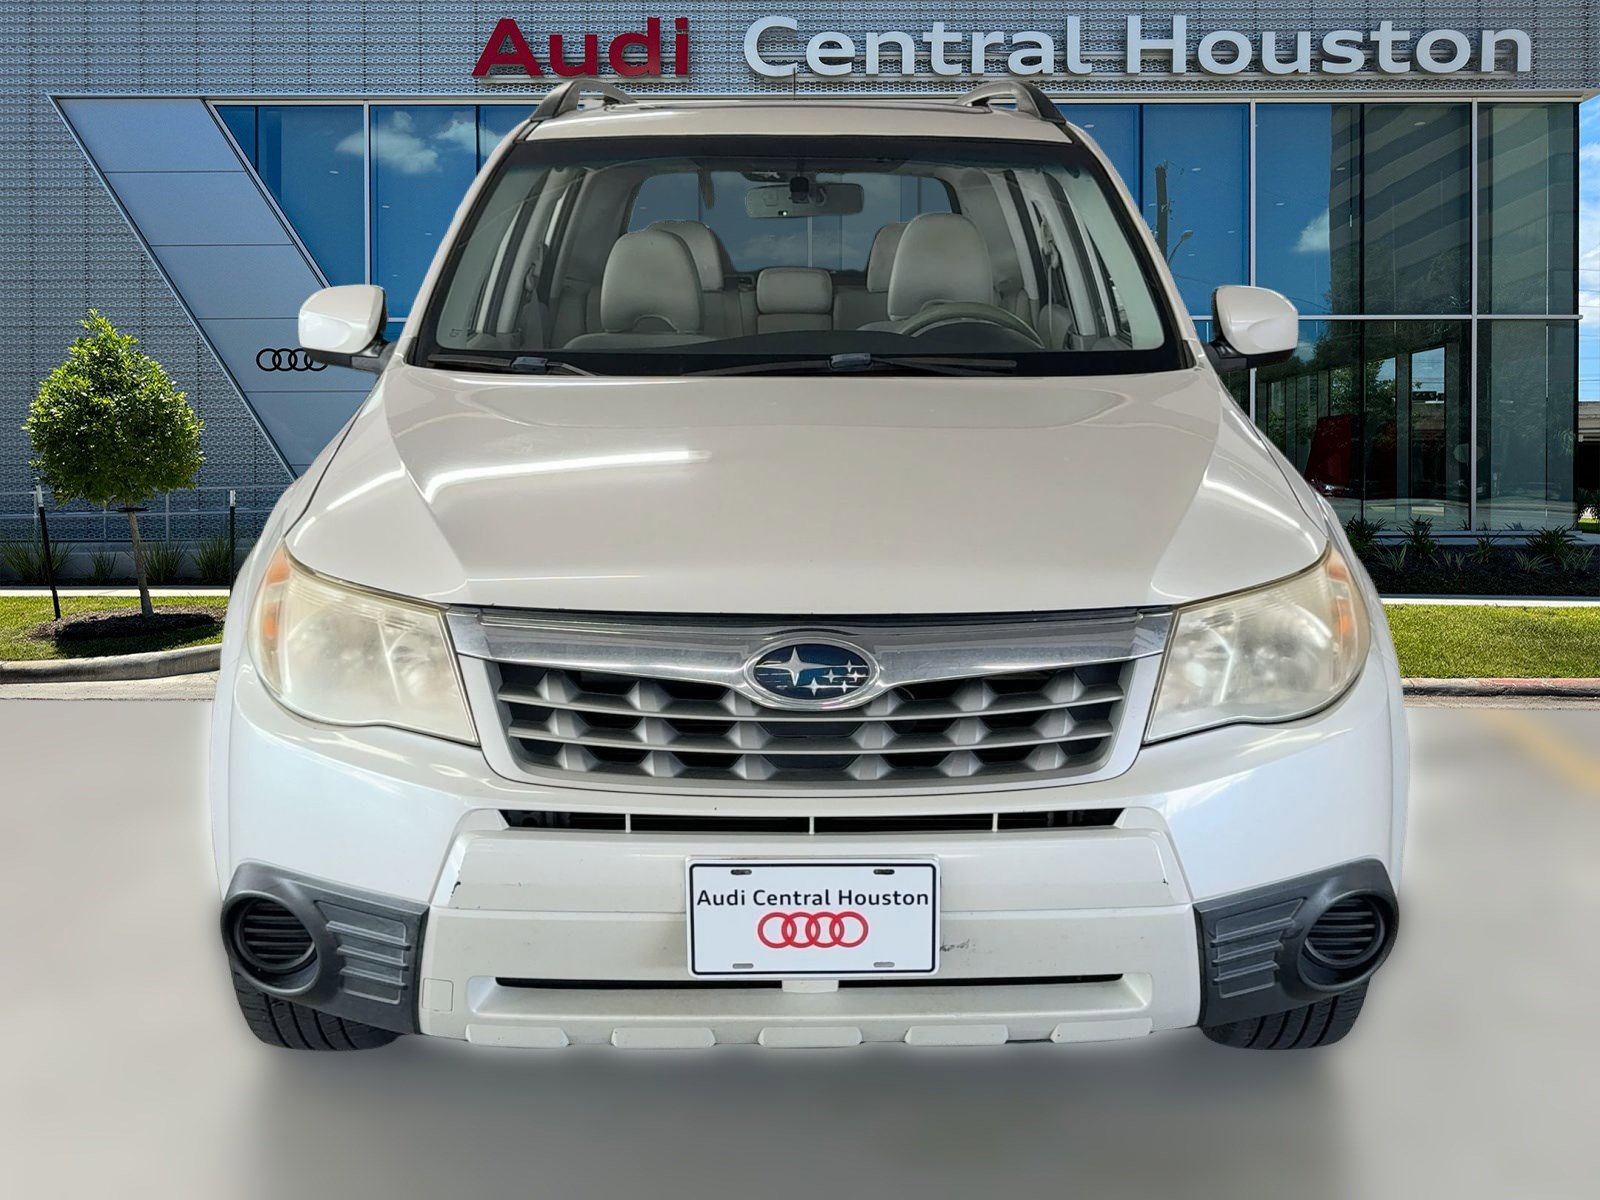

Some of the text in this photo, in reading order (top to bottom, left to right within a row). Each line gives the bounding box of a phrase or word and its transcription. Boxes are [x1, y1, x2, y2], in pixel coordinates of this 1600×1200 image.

[471, 15, 1532, 77] Audi Central Houston
[697, 889, 929, 906] Audi Central Houston
